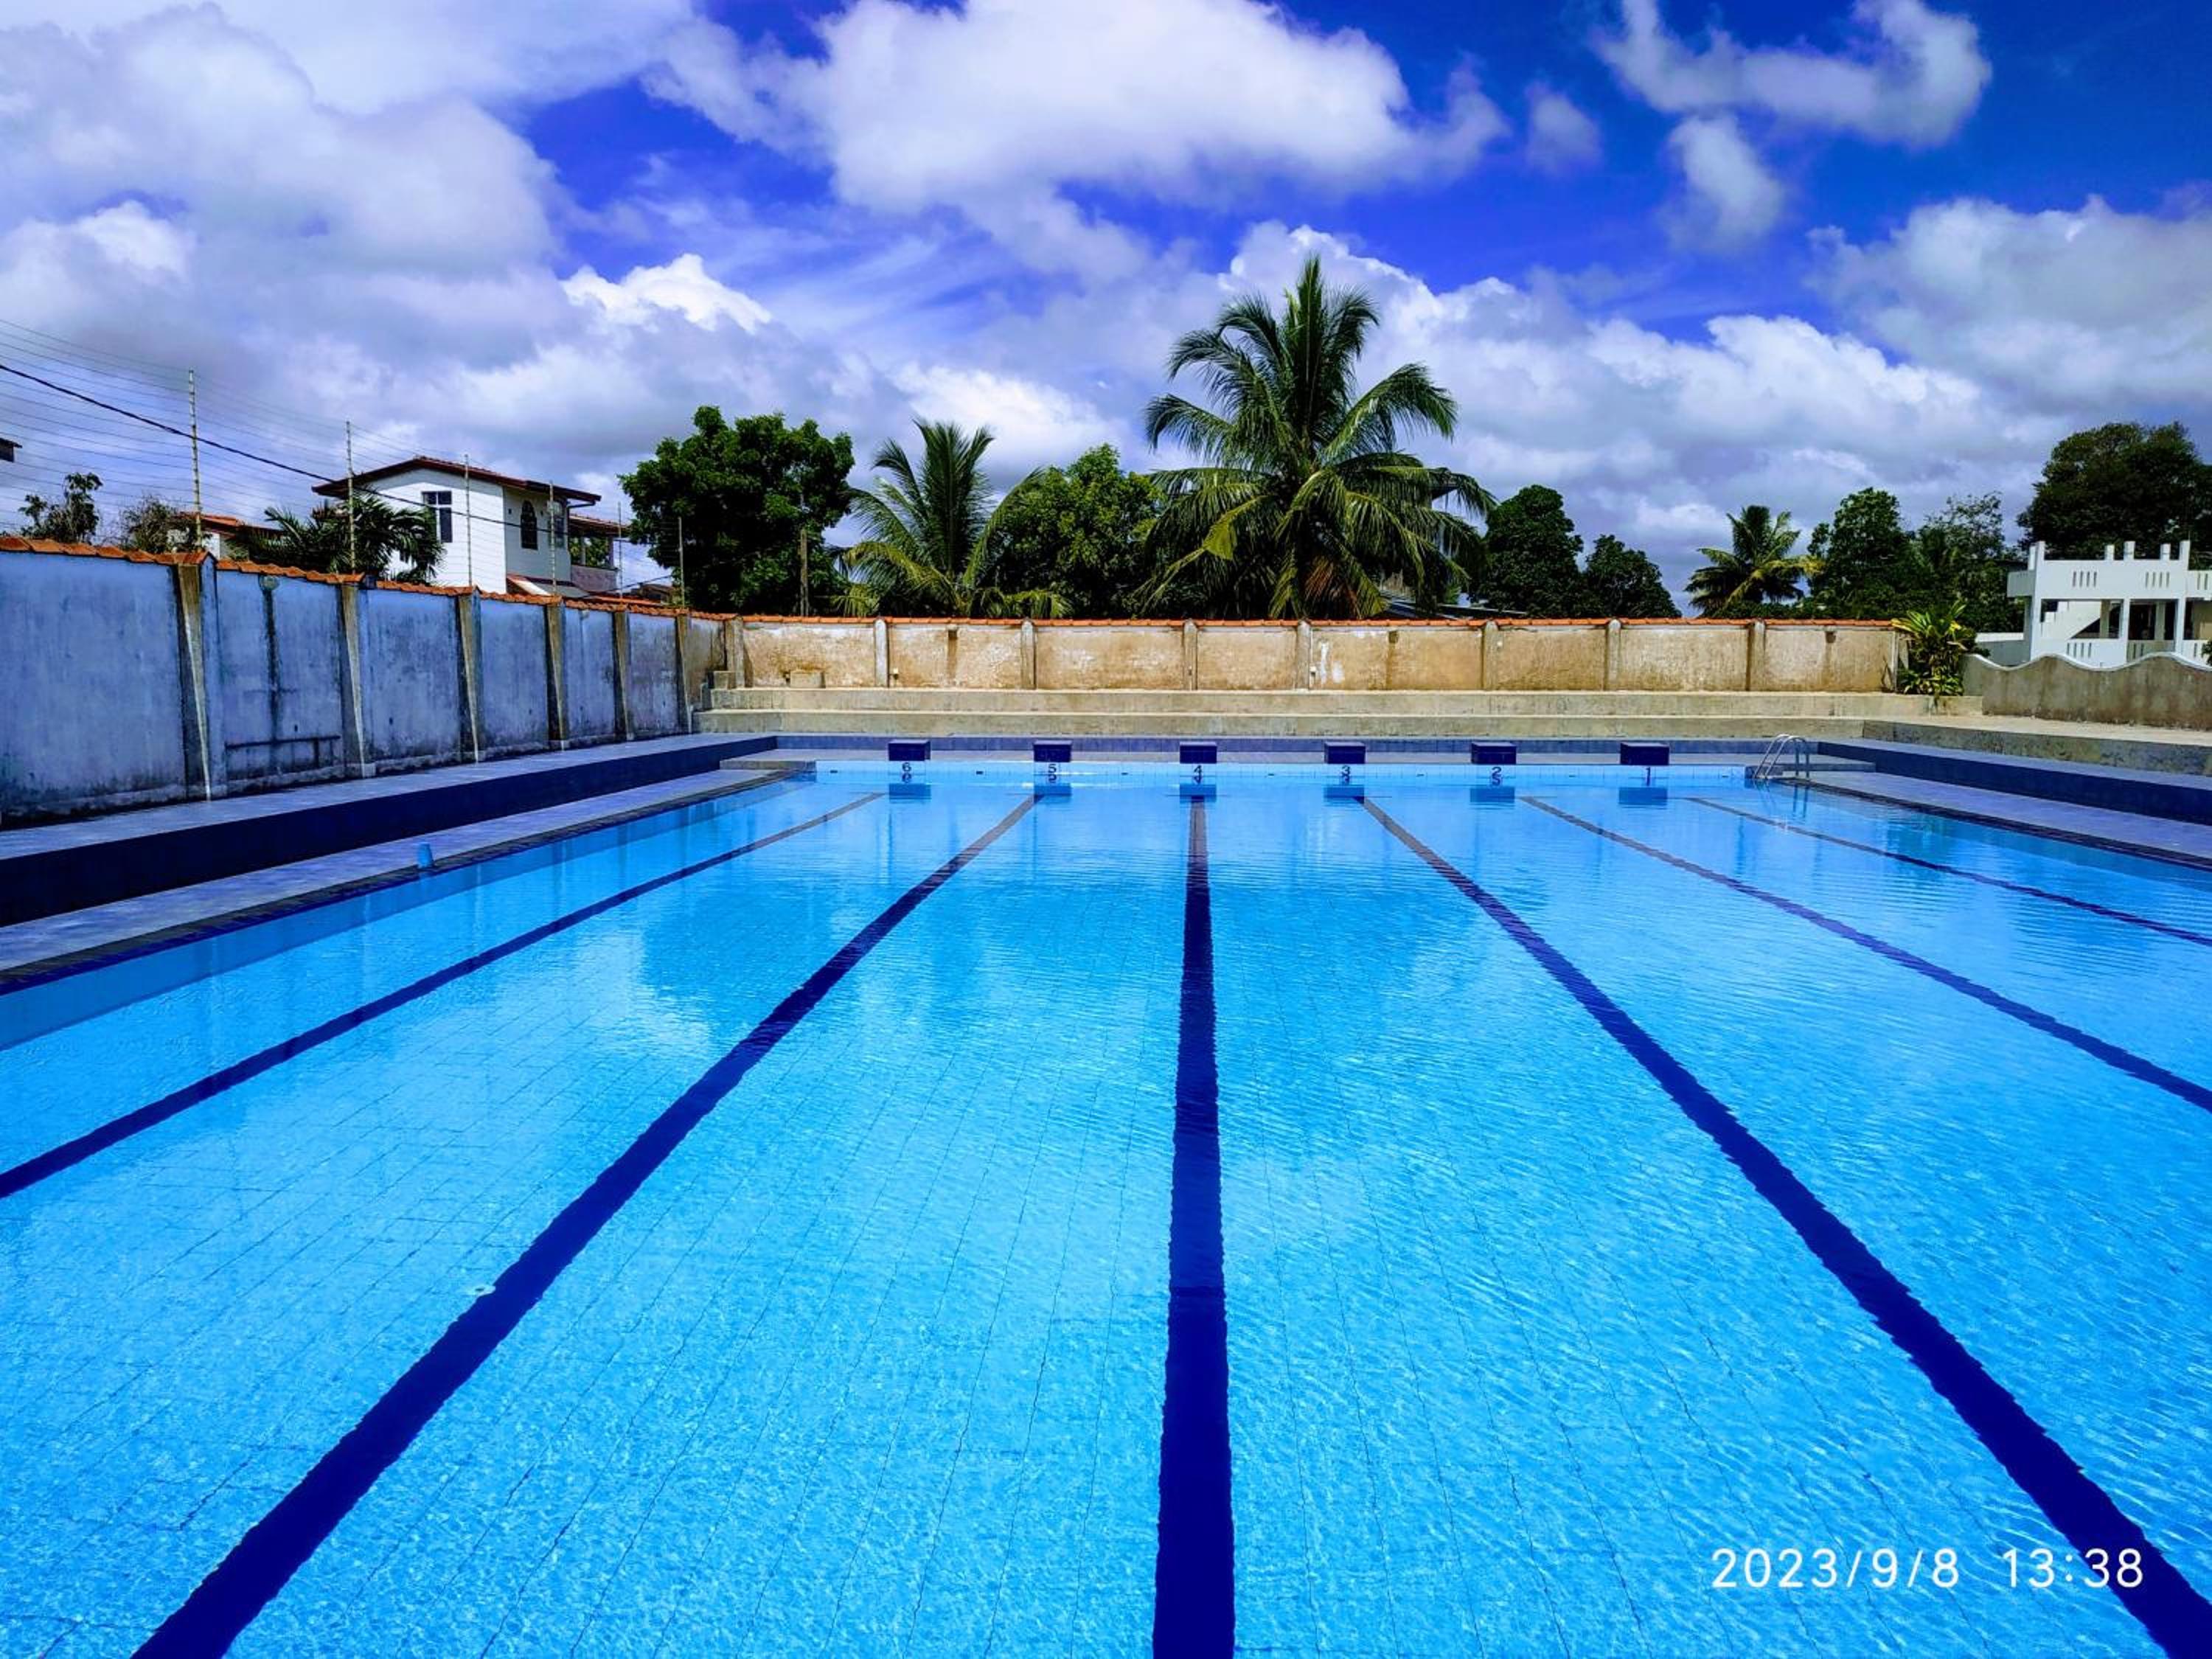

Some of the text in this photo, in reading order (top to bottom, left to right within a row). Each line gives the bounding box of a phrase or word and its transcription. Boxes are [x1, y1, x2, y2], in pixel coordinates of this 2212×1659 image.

[902, 762, 911, 772] 6
[1048, 763, 1057, 773] 5
[1193, 765, 1203, 775] 4
[1341, 765, 1351, 775] 3
[1492, 766, 1502, 775] 2
